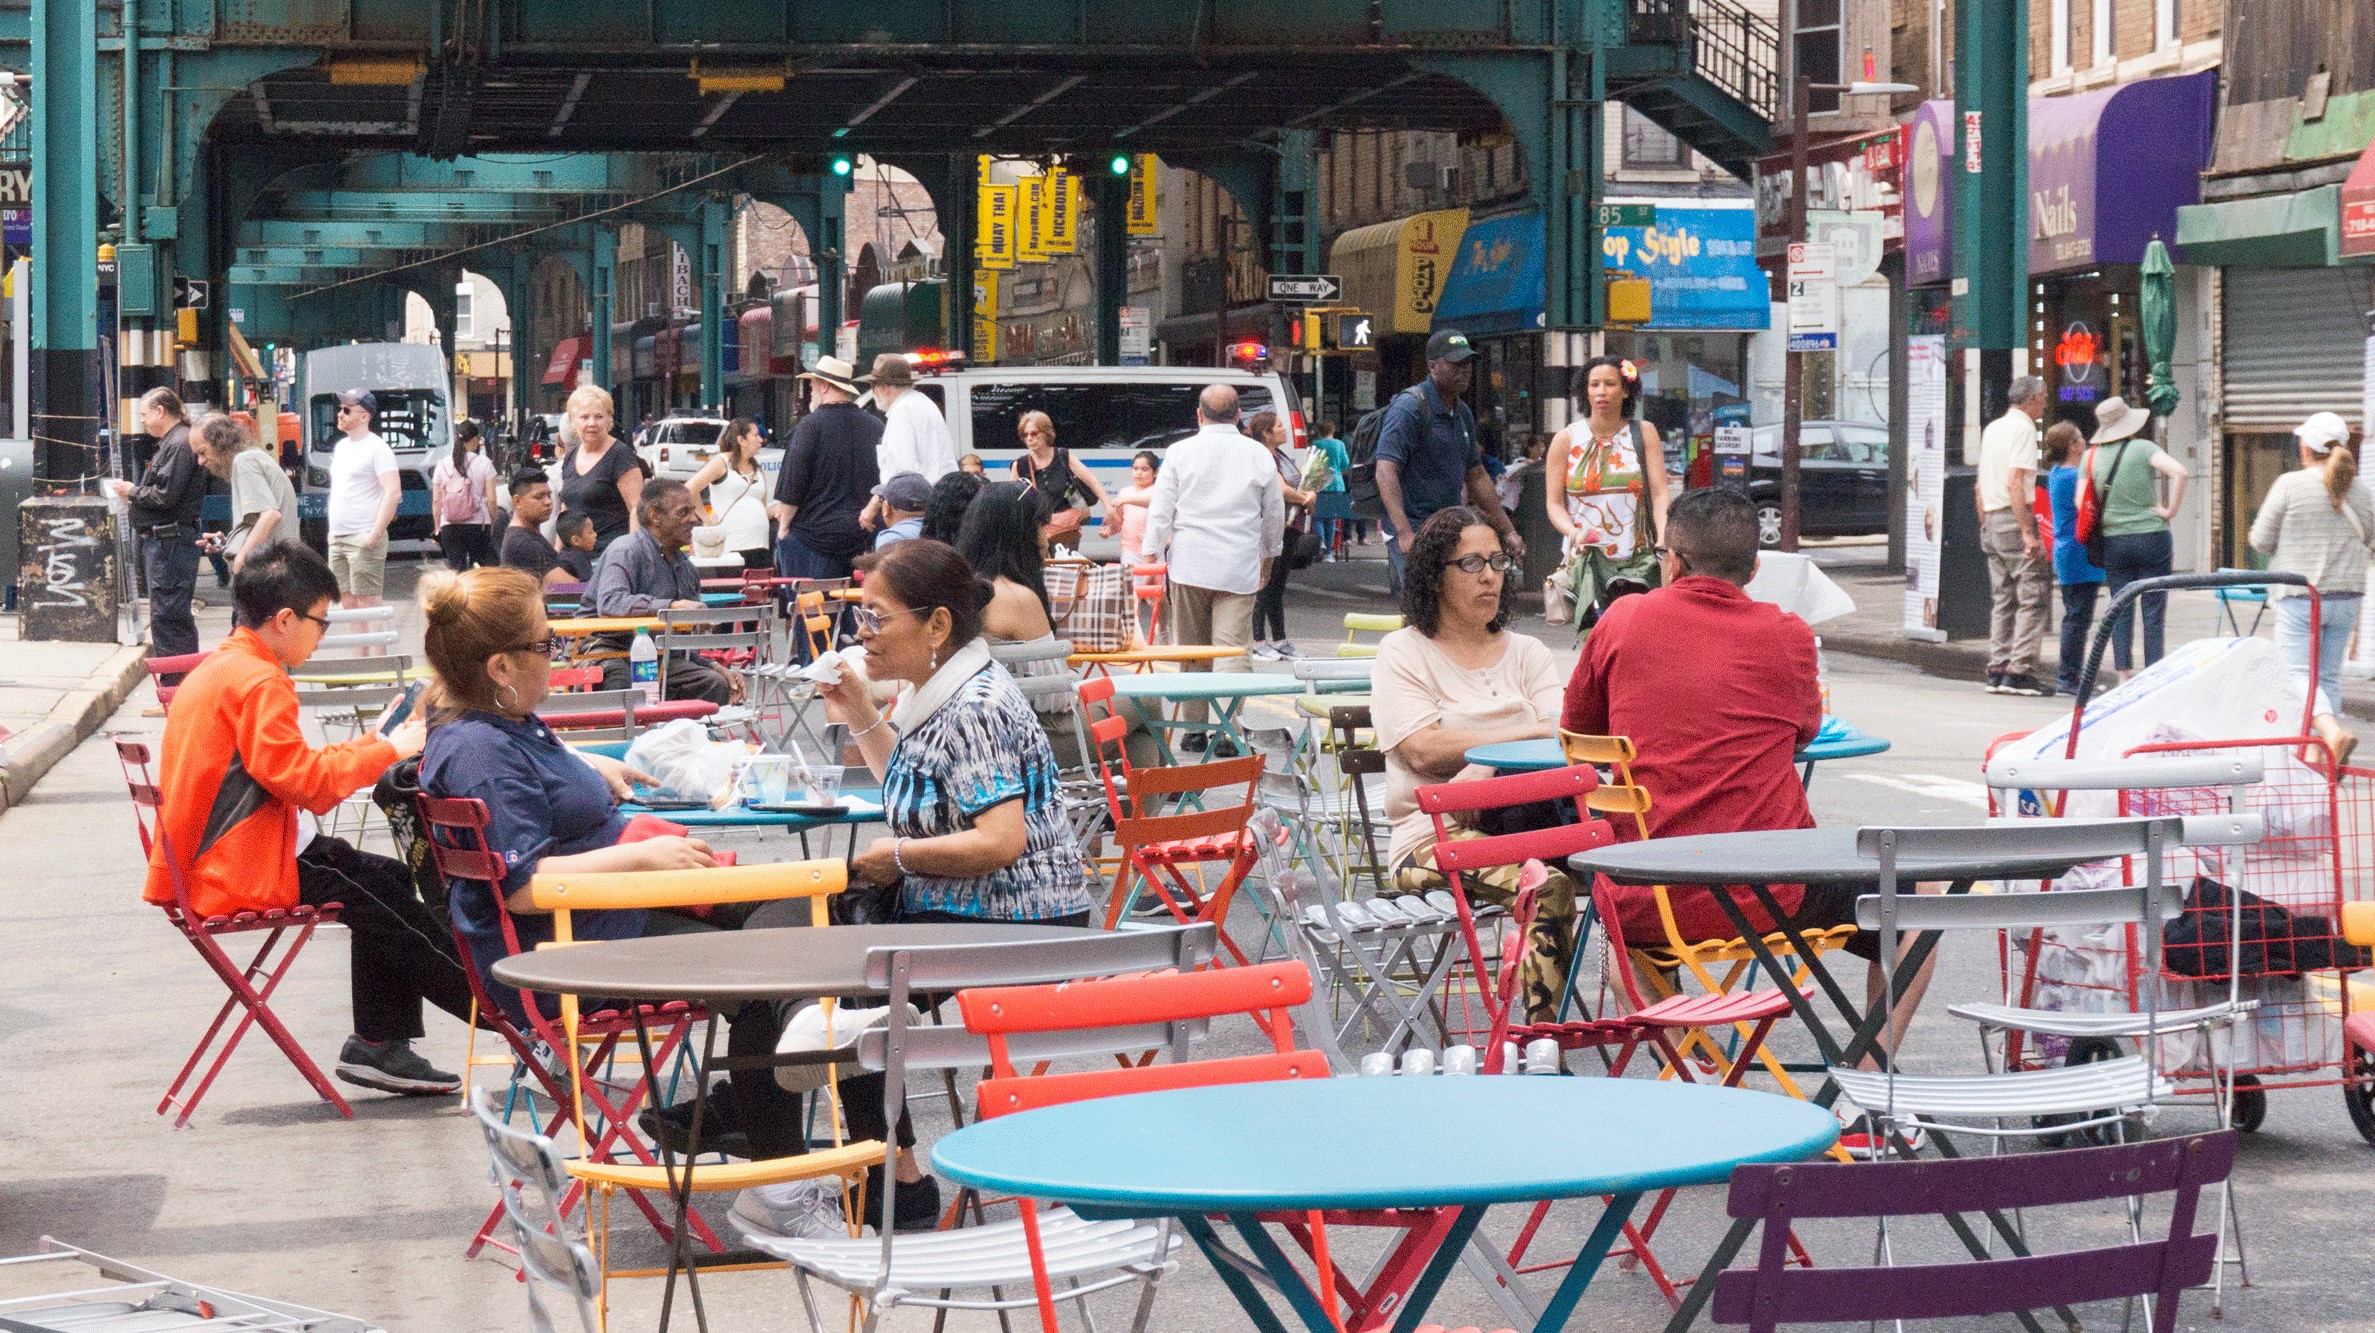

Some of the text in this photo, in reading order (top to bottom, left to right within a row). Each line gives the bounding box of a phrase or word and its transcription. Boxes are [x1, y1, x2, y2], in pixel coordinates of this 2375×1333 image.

[993, 192, 1006, 217] THAI
[1600, 206, 1621, 224] 85
[2034, 184, 2077, 239] Nails
[992, 222, 1005, 254] MUAY
[1603, 229, 1630, 266] op
[1636, 227, 1701, 266] Style
[1280, 282, 1329, 292] ONE WAY
